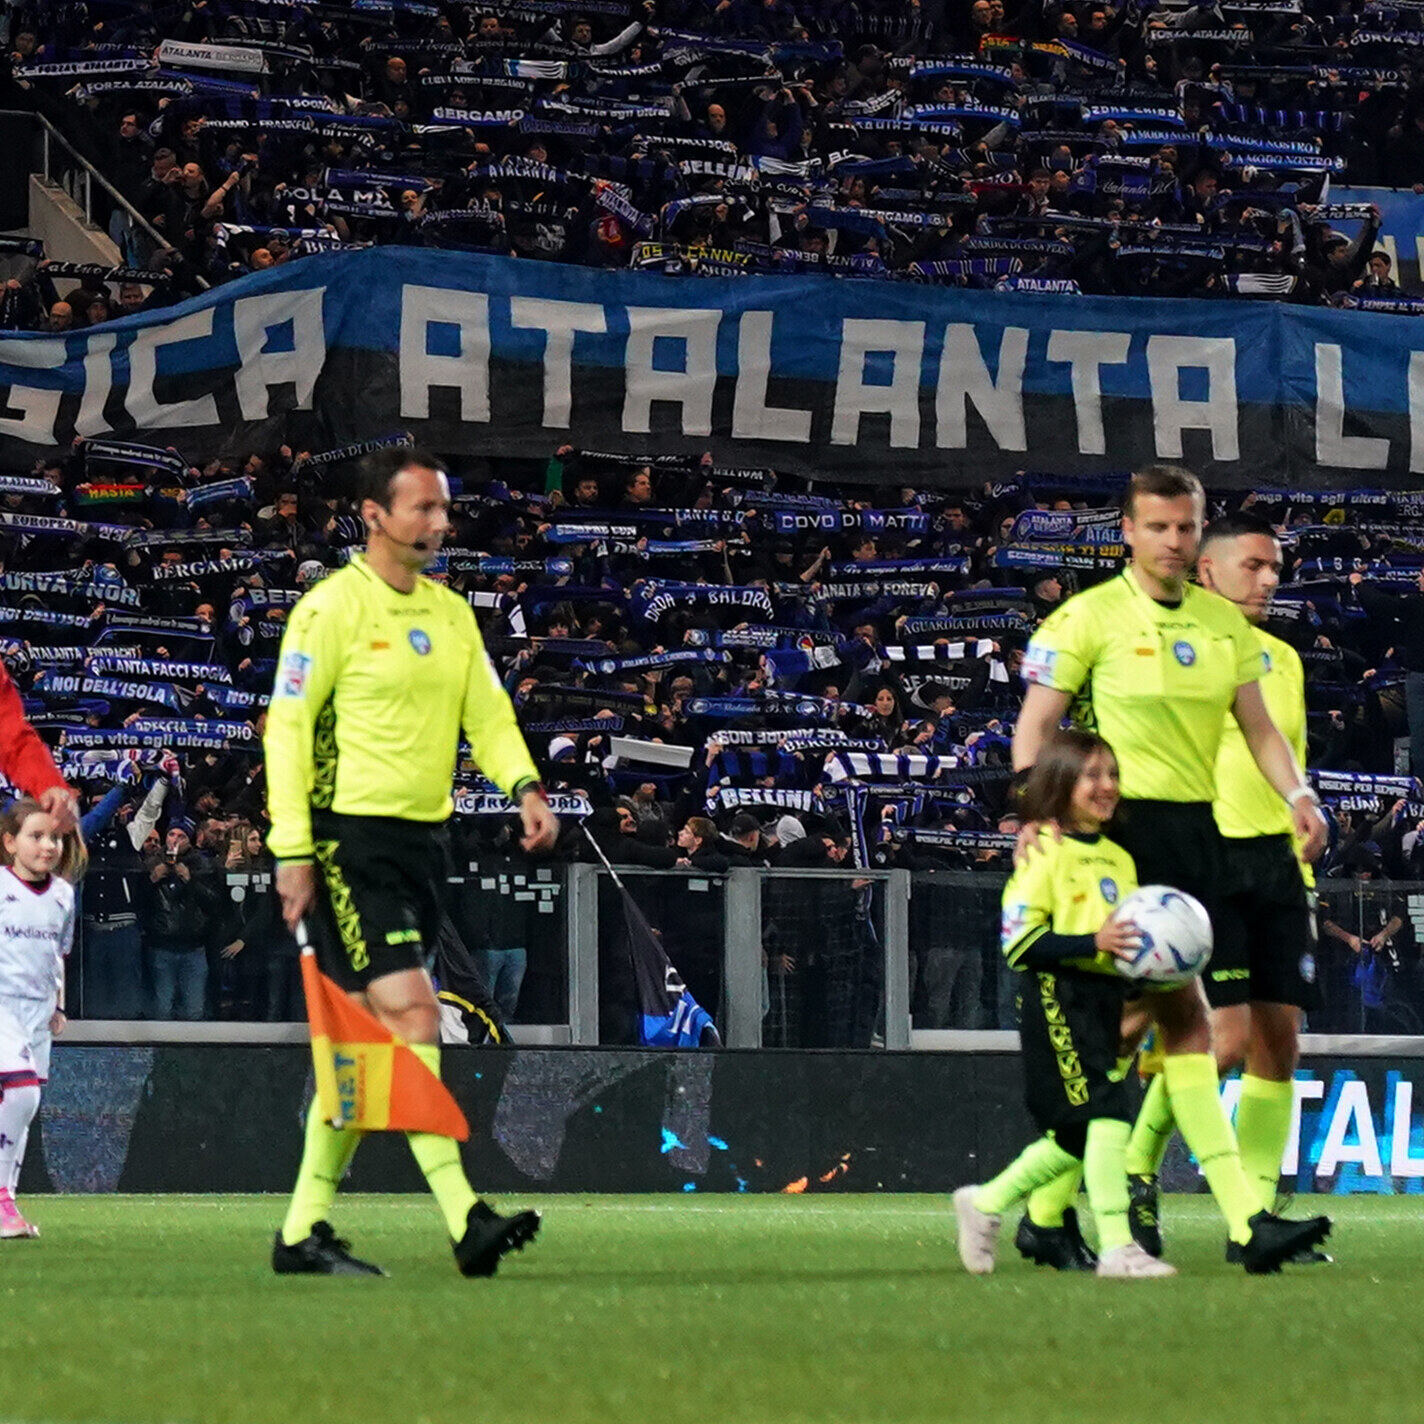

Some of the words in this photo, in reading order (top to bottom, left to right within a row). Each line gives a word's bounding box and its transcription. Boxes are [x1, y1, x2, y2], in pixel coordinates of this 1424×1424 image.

[1017, 278, 1074, 292] ATALANTA
[399, 282, 1241, 462] ATALANTA
[1314, 342, 1424, 474] L
[1320, 493, 1346, 507] agli
[782, 513, 837, 531] COVO
[842, 514, 861, 530] DI
[869, 515, 925, 531] MATTI
[153, 558, 252, 579] BERGAMO
[30, 645, 82, 661] ATALANTA
[51, 676, 79, 692] NOI
[81, 678, 167, 702] DELL'ISOLA
[110, 733, 138, 746] vita
[143, 734, 173, 750] agli
[178, 736, 224, 751] ultras
[721, 788, 812, 811] BELLINI
